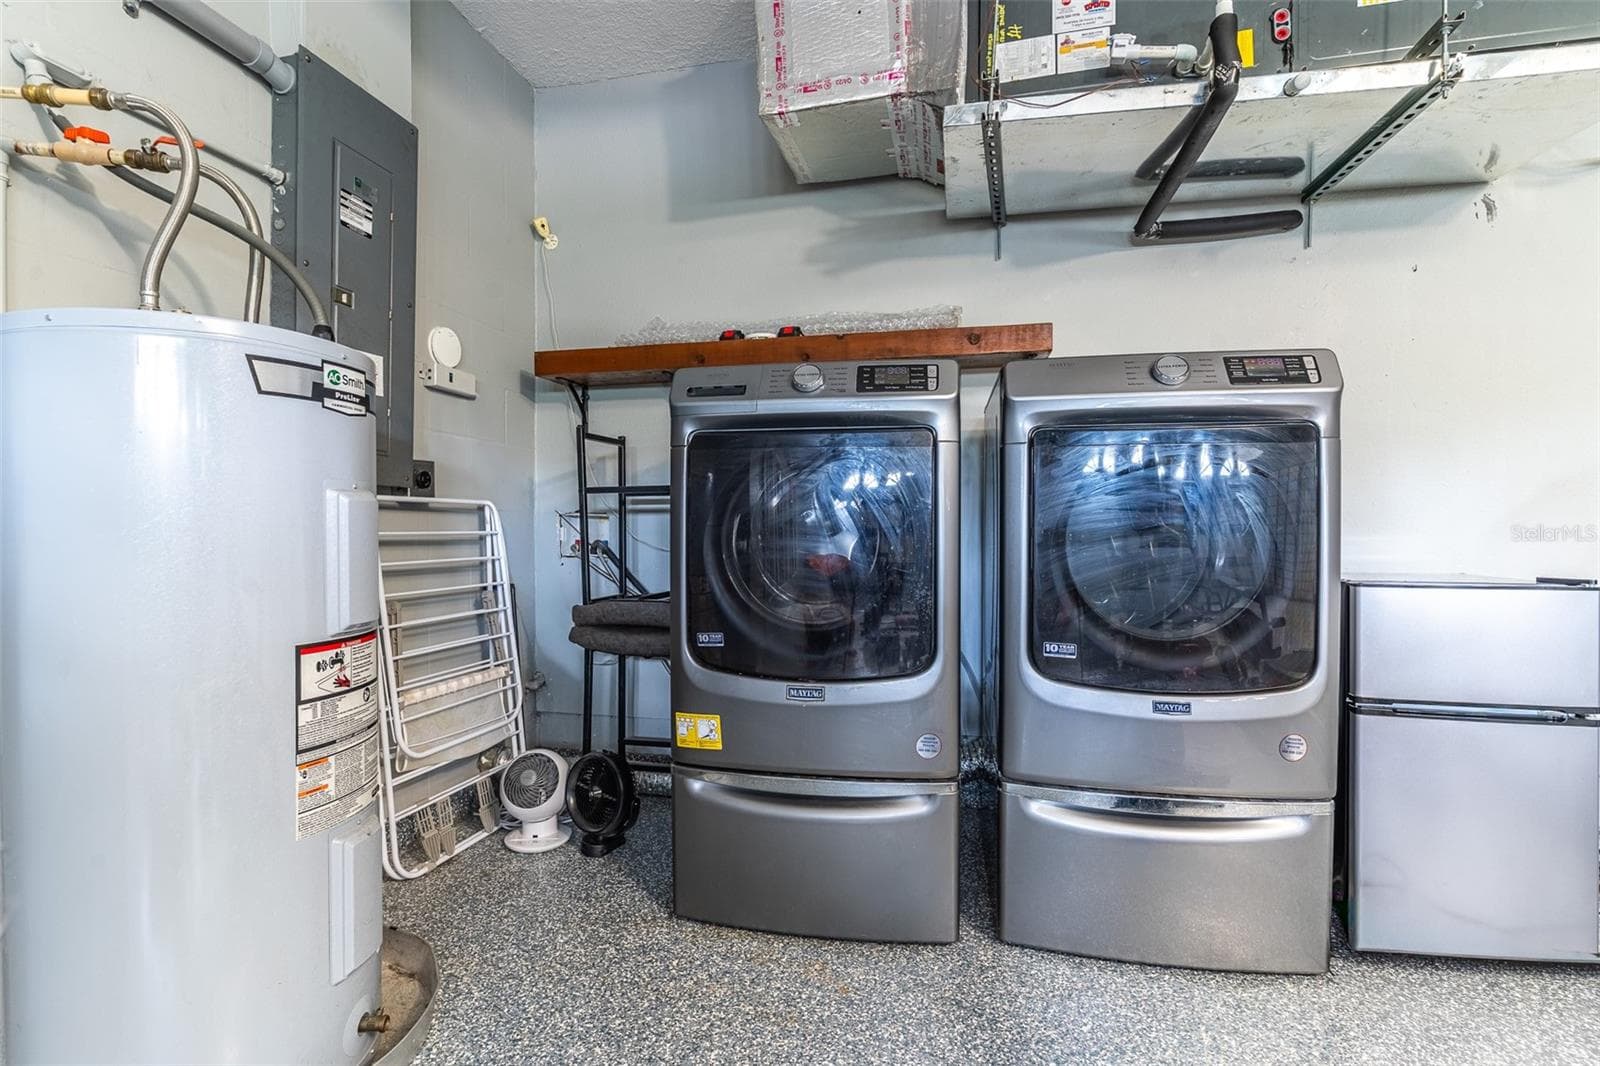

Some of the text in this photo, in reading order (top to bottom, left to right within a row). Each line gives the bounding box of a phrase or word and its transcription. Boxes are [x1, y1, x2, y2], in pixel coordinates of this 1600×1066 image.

[342, 374, 364, 390] Smith
[699, 634, 708, 642] 10
[1045, 643, 1059, 652] 10
[790, 689, 822, 697] MAYTAG
[1156, 703, 1190, 712] MAYTAG
